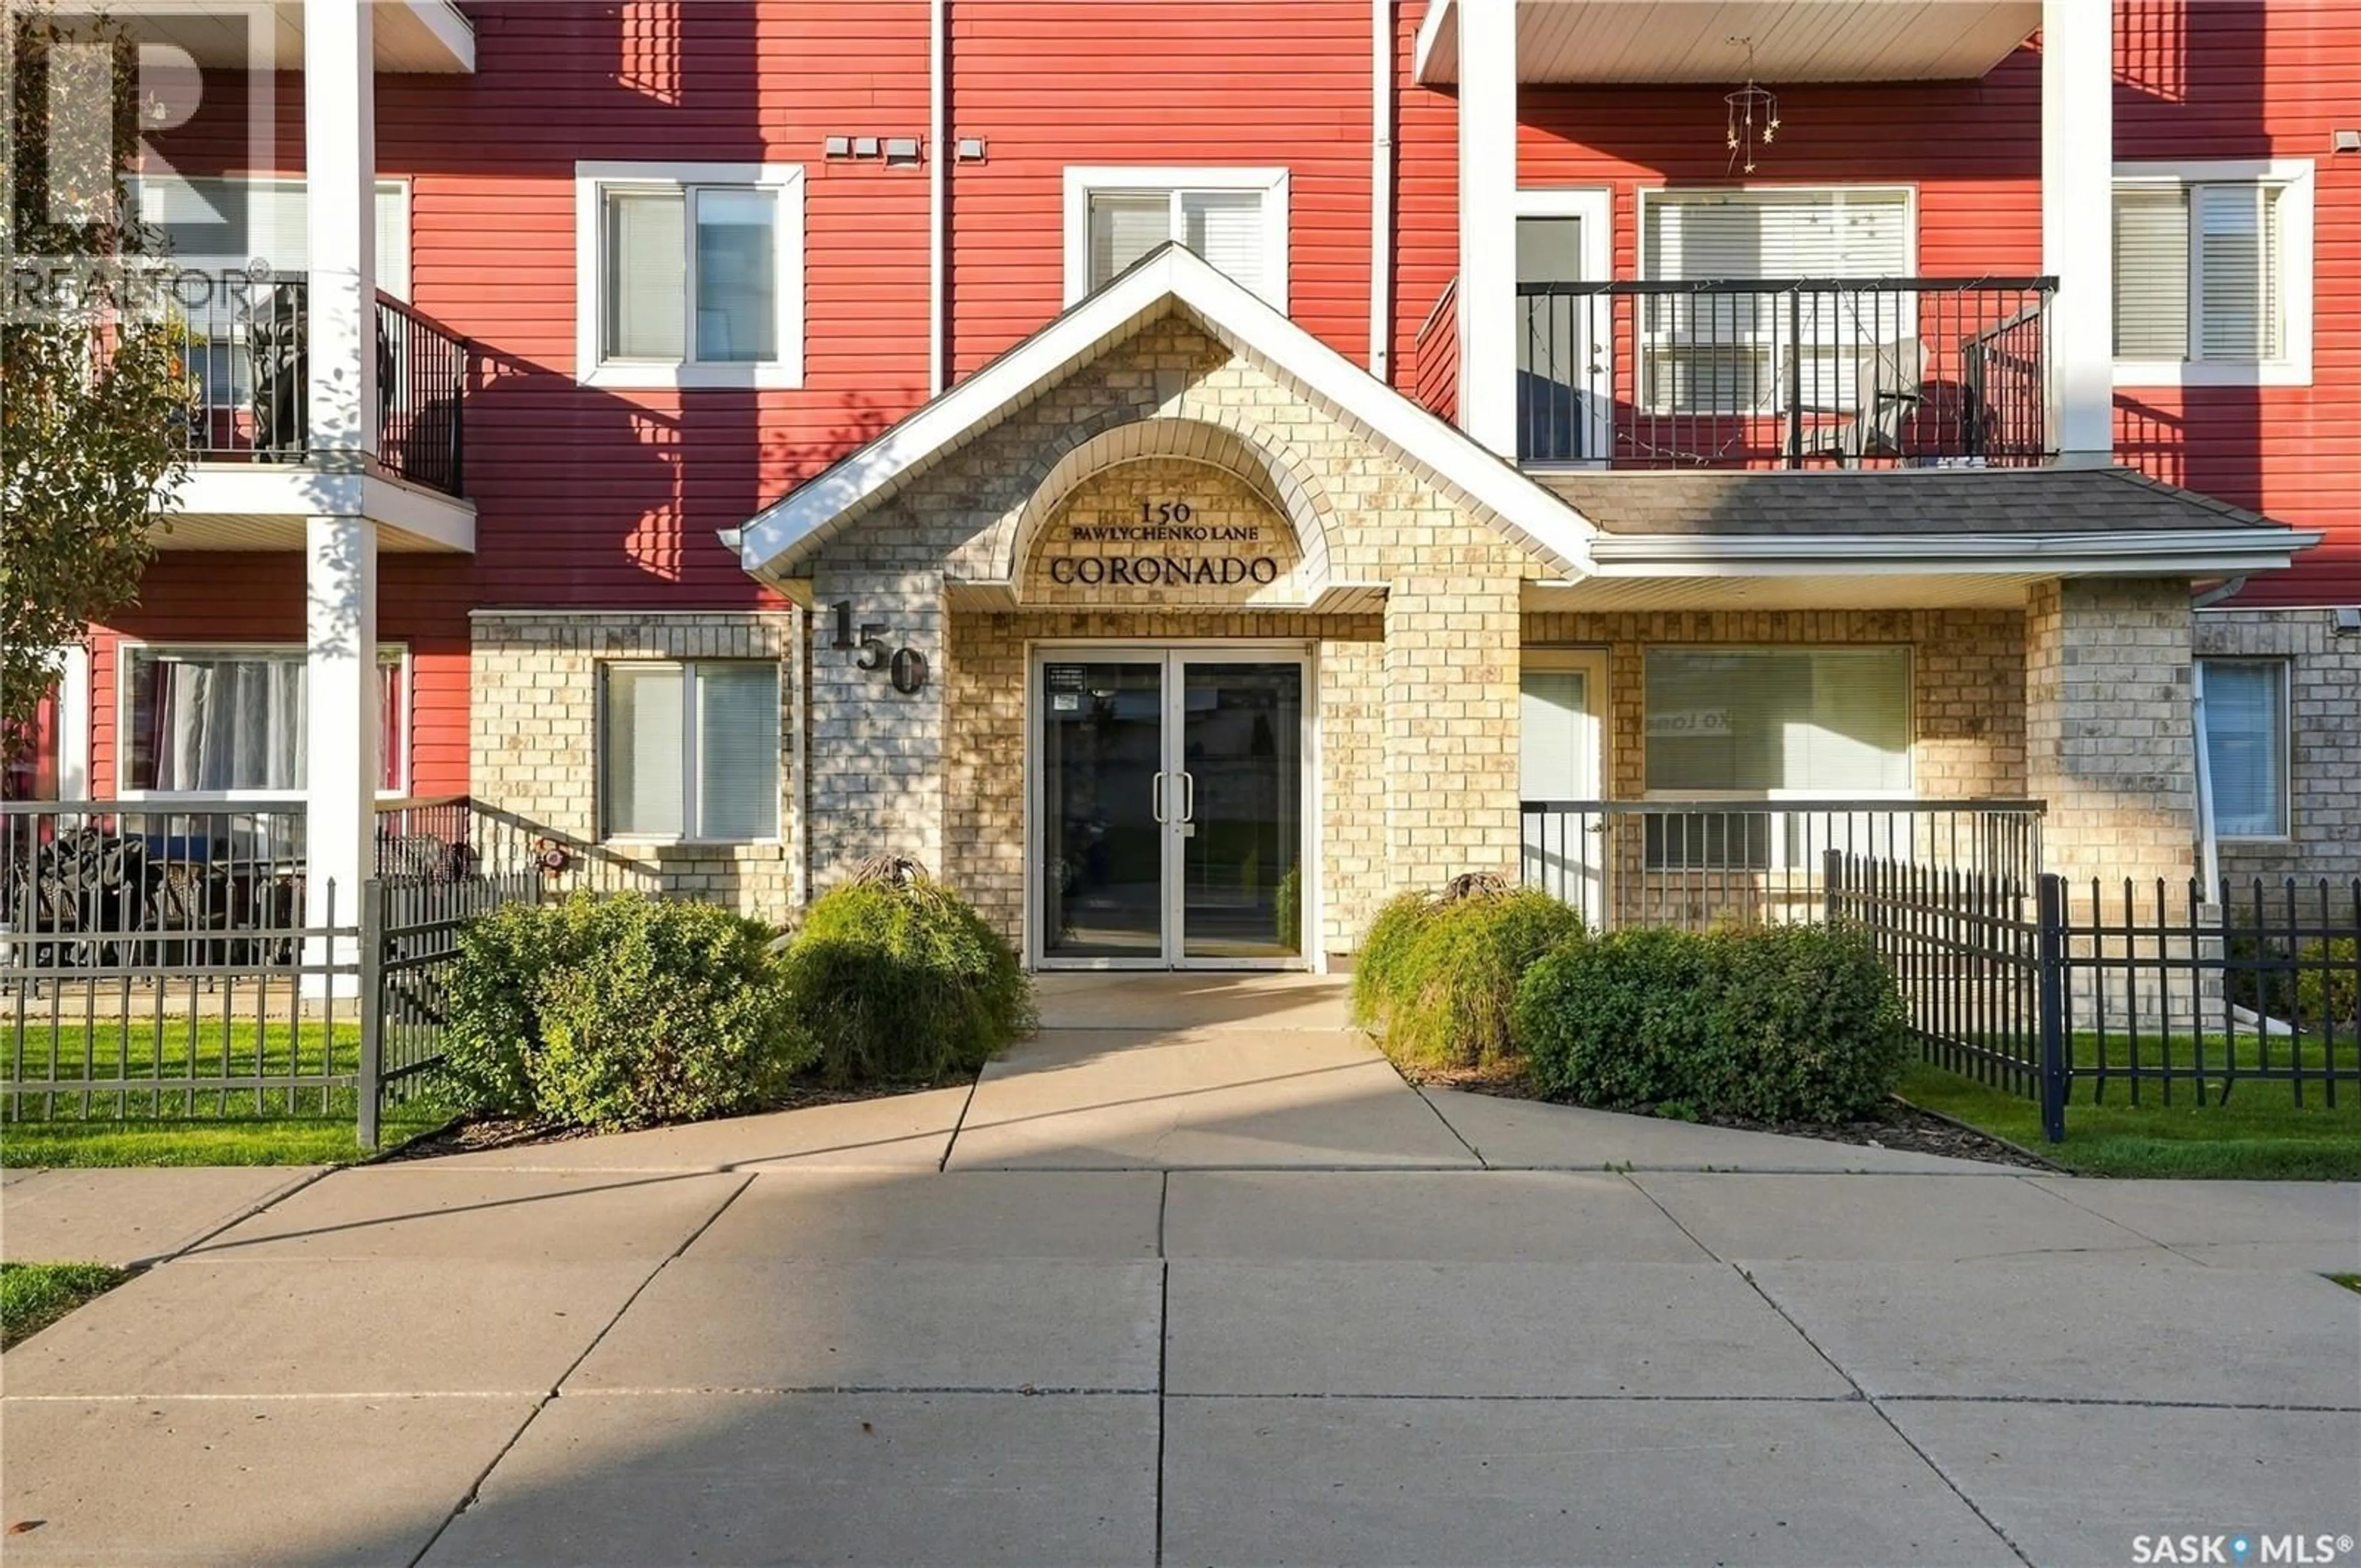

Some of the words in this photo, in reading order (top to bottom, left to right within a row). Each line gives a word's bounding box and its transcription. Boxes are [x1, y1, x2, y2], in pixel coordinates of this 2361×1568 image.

[1142, 503, 1191, 524] 150
[1072, 527, 1208, 541] PAWLYCHENKO
[1211, 527, 1259, 541] LANE
[1051, 556, 1278, 585] CORONADO
[831, 600, 929, 695] 150
